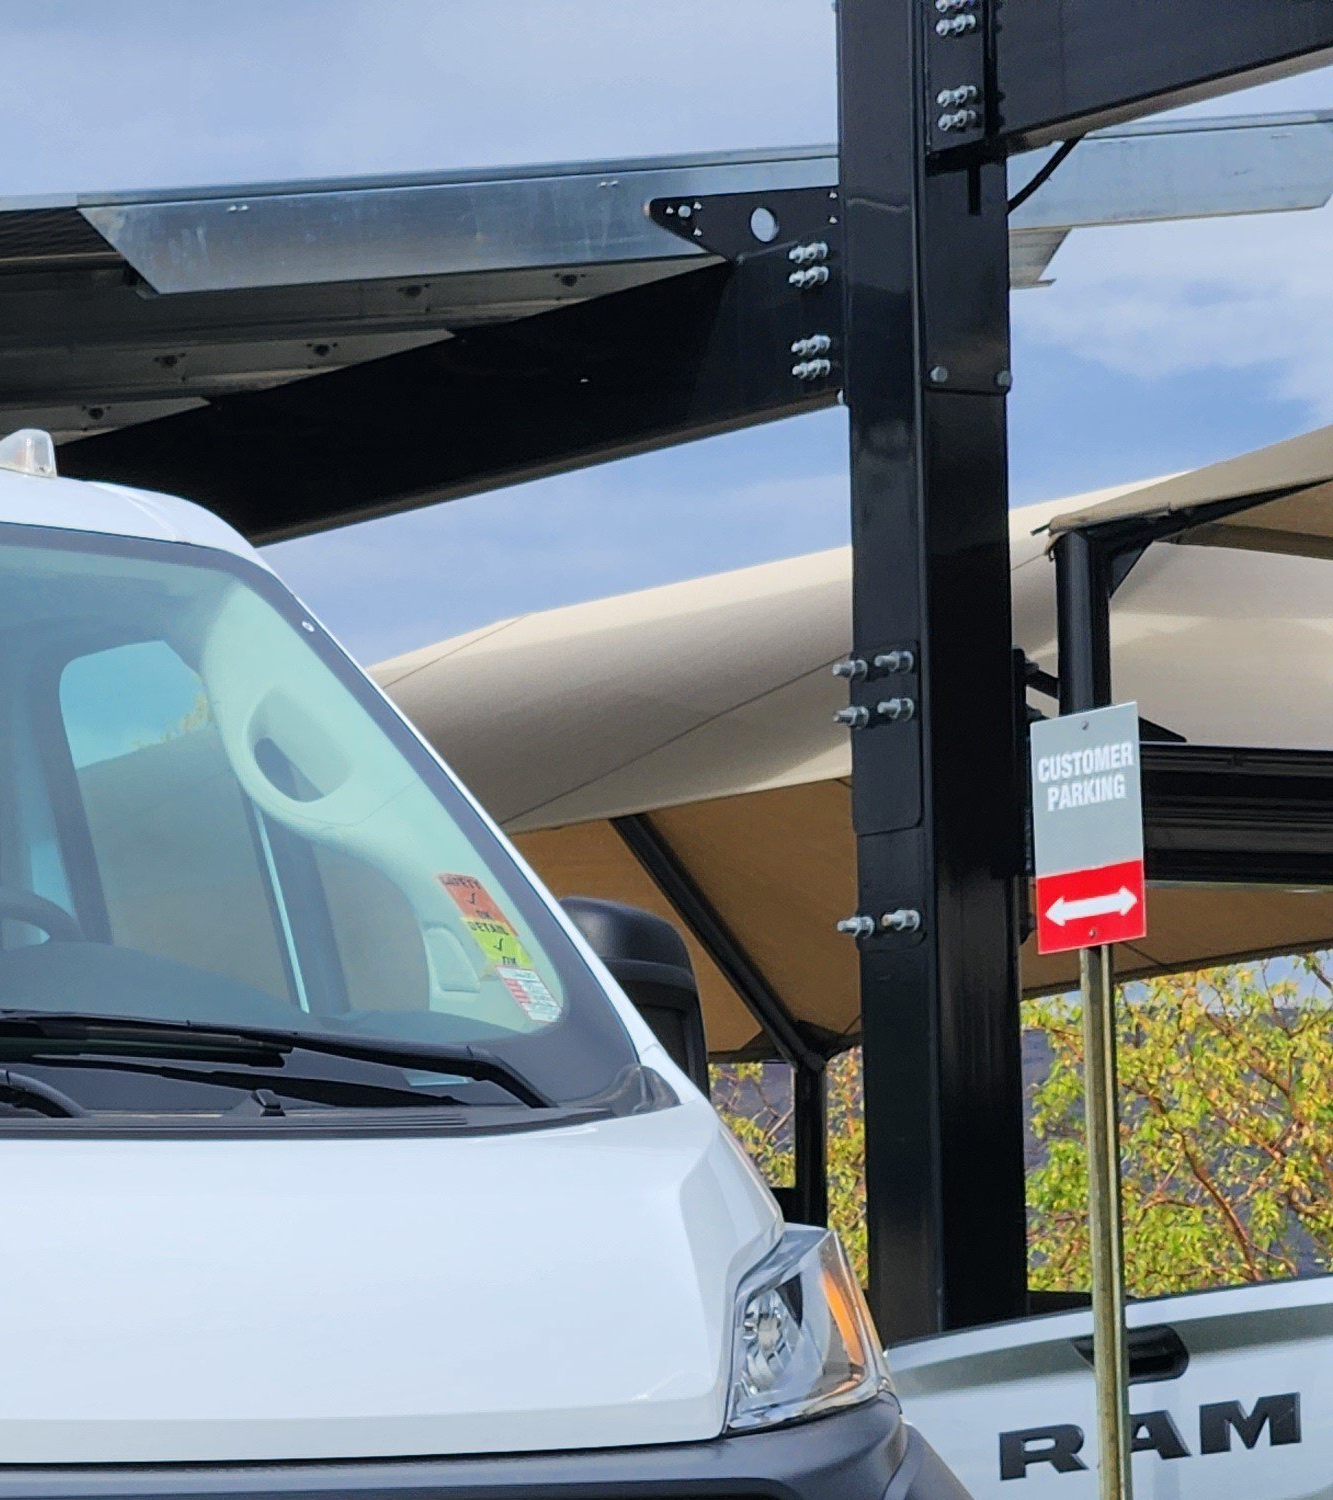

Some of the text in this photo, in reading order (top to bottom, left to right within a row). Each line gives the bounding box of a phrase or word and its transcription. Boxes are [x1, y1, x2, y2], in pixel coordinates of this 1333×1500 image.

[1037, 741, 1134, 783] CUSTOMER
[1047, 773, 1126, 812] PARKING
[999, 1392, 1301, 1481] RAM
